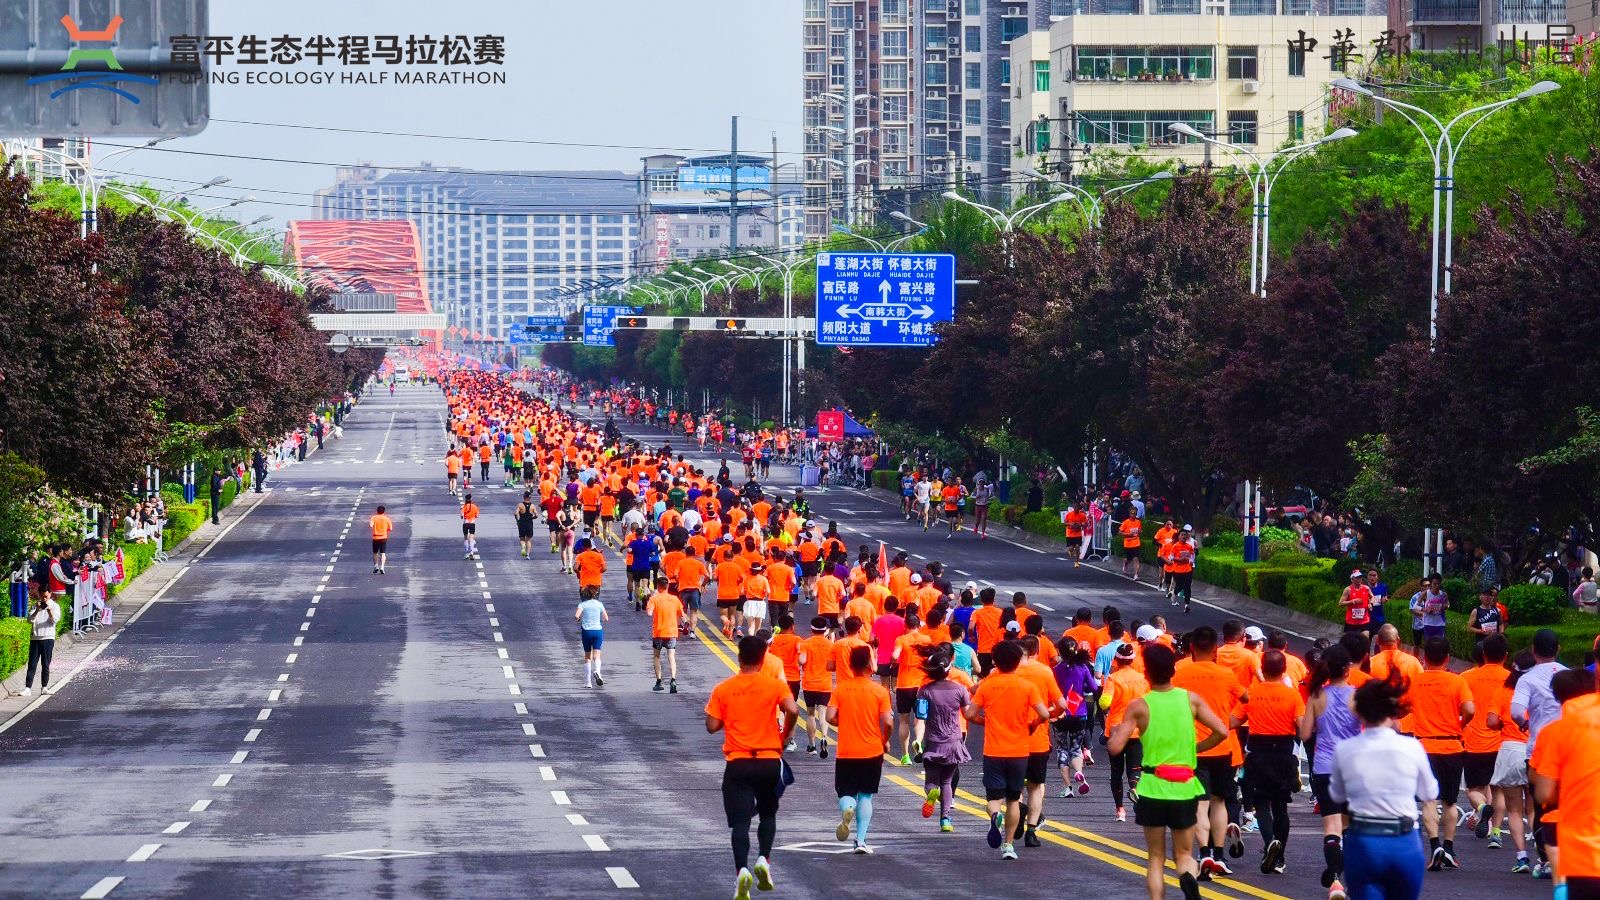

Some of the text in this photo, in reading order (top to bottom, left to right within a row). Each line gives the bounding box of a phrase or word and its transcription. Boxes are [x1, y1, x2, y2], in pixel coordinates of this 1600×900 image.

[887, 257, 937, 271] 怀德大街
[822, 280, 860, 294] 富民路
[899, 282, 936, 296] 富兴路
[822, 320, 872, 335] 频阳大道
[898, 321, 940, 336] 环城东
